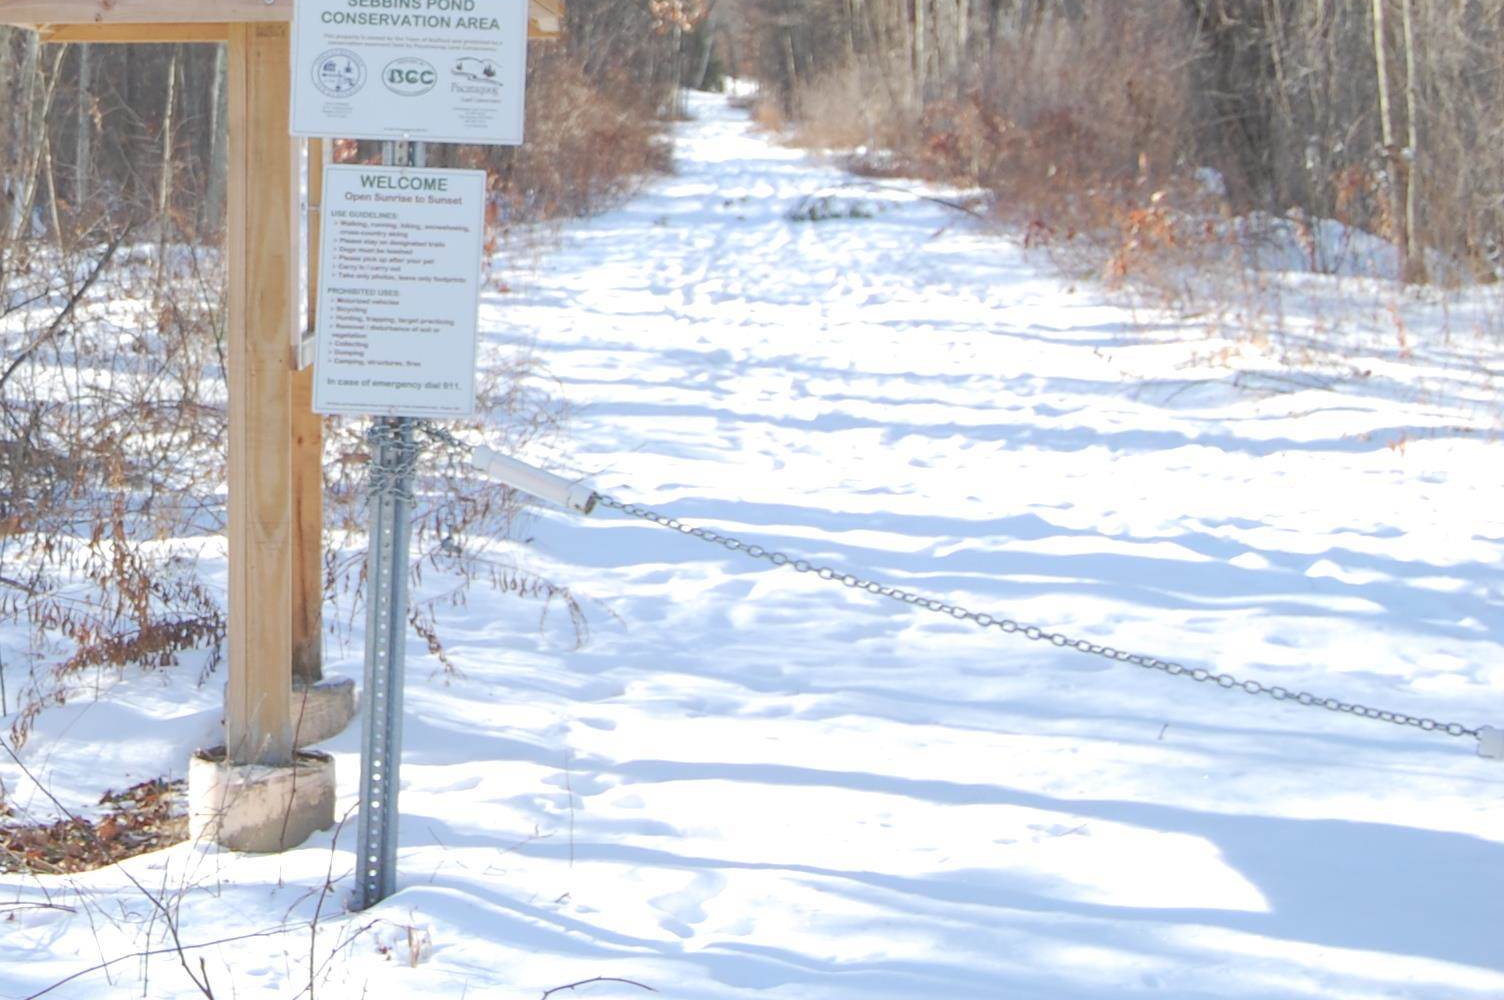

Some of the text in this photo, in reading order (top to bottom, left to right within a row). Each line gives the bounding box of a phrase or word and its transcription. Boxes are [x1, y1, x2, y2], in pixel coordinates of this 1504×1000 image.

[321, 11, 500, 30] CONSERVATION AREA
[388, 68, 434, 84] BCC
[360, 174, 448, 191] WELCOME
[344, 192, 462, 205] Open Sunrise to Sunset
[327, 378, 336, 386] In
[338, 379, 360, 387] case
[361, 379, 370, 387] of
[372, 380, 422, 391] emergency
[424, 381, 441, 389] dial
